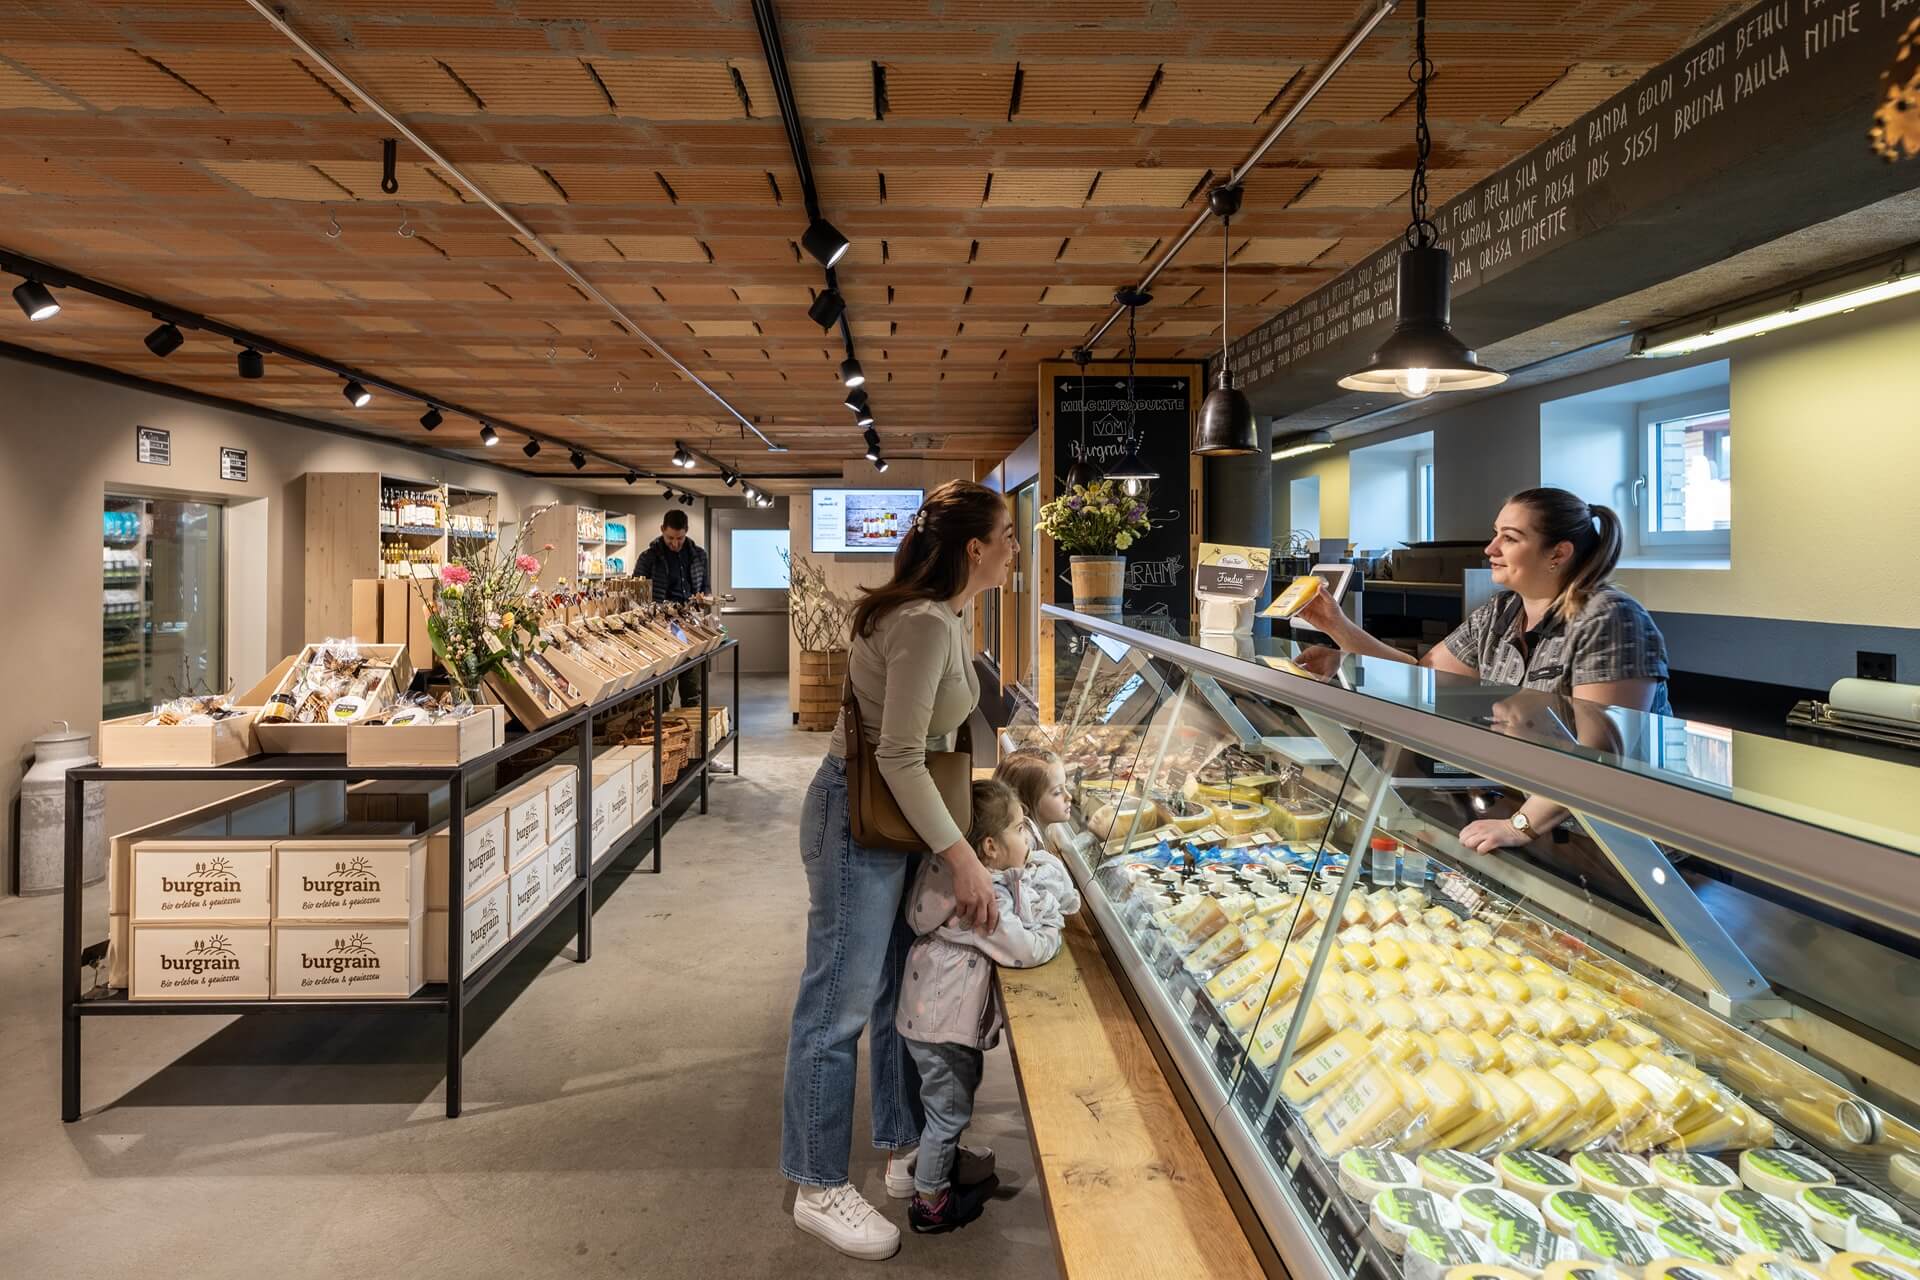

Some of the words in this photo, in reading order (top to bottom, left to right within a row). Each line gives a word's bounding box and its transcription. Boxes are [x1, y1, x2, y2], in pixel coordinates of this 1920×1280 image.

[1460, 218, 1492, 251] SANDRA
[1497, 194, 1538, 233] SALOME
[1544, 172, 1575, 207] PRISA
[1587, 151, 1610, 185] IRIS
[1621, 122, 1659, 166] SISSI
[1672, 84, 1725, 140] BRUNA
[1734, 45, 1790, 103] PAULA
[1804, 2, 1860, 60] NINE
[1484, 178, 1509, 214] BELLA
[1516, 160, 1538, 196] SILA
[1545, 134, 1577, 172] OMEGA
[1588, 102, 1628, 147] PANDA
[1637, 73, 1673, 116] GOLDI
[1683, 40, 1726, 89] STERN
[1450, 256, 1472, 284] ANA
[1479, 236, 1513, 271] ORISSA
[1520, 206, 1568, 252] FINETTE
[1061, 399, 1185, 413] MILCHPRODUKTE
[1095, 422, 1125, 436] VOM
[1132, 562, 1174, 584] RAHM
[1216, 571, 1244, 585] Fondue
[516, 819, 539, 841] burgrain
[468, 846, 496, 872] burgrain
[162, 877, 242, 897] burgrain
[302, 876, 381, 896] burgrain
[517, 881, 541, 907] burgrain
[161, 902, 173, 911] Bio
[175, 899, 200, 909] erleben
[209, 897, 241, 910] geniessen
[302, 901, 314, 910] Bio
[315, 899, 340, 908] erleben
[349, 897, 381, 909] geniessen
[470, 914, 500, 944] burgrain
[160, 955, 240, 974] burgrain
[301, 953, 380, 973] burgrain
[160, 979, 172, 988] Bio
[174, 976, 199, 987] erleben
[208, 974, 240, 987] geniessen
[301, 978, 313, 987] Bio
[314, 976, 339, 986] erleben
[348, 973, 380, 986] geniessen
